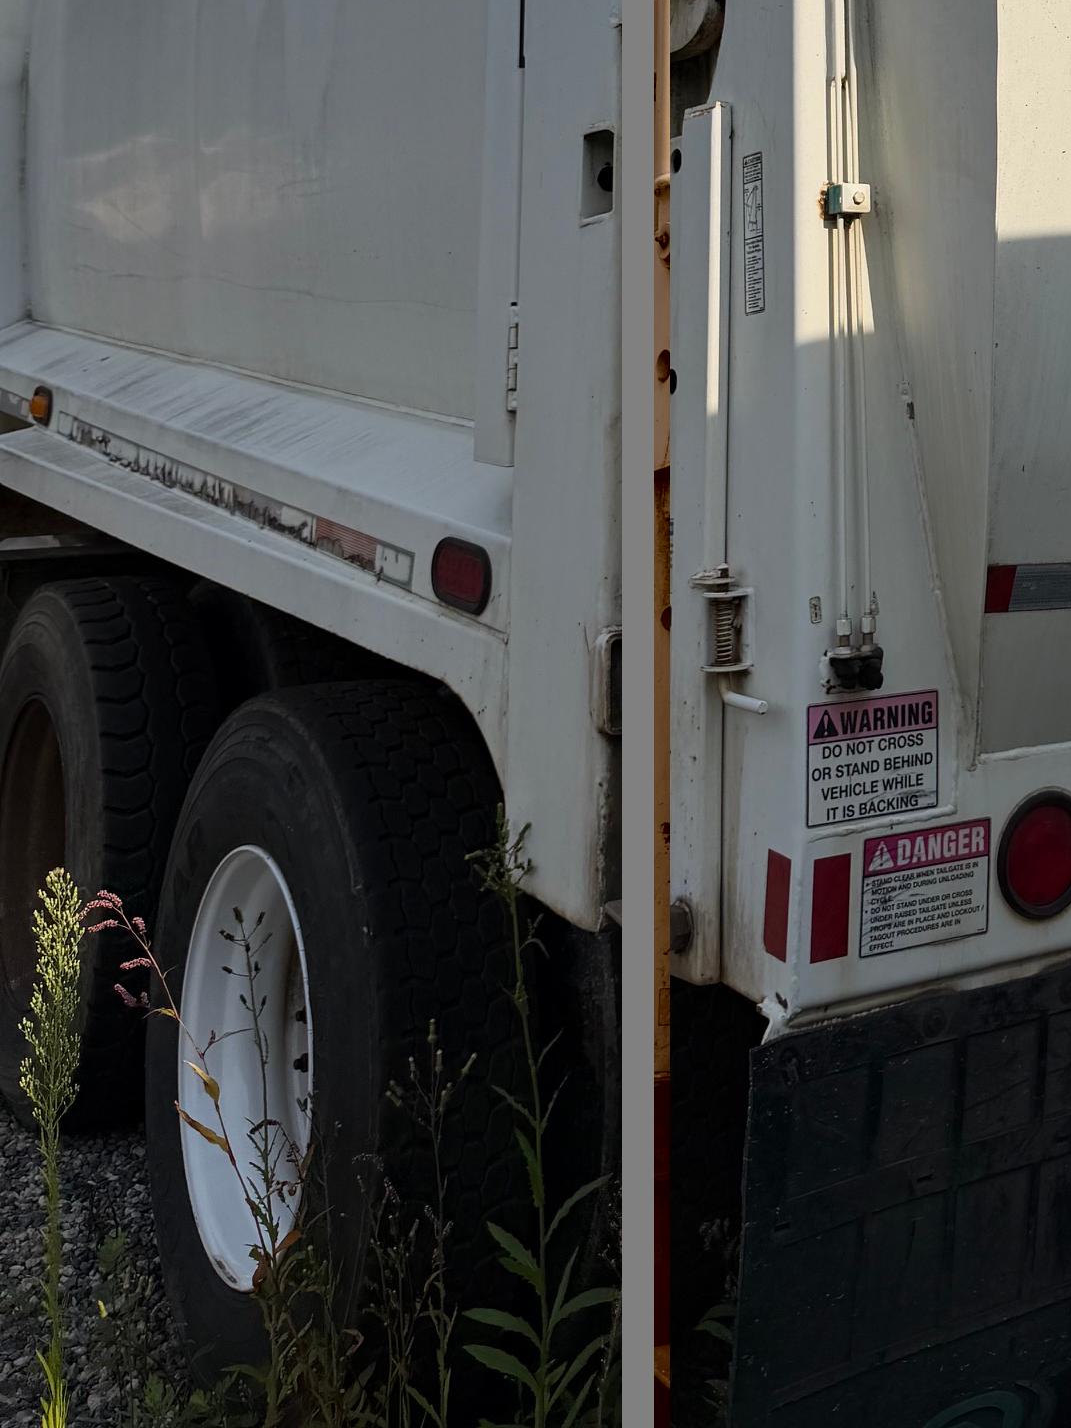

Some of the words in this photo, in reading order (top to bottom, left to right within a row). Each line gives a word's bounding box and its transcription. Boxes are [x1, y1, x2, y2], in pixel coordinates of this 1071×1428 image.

[840, 700, 933, 735] WARNING
[823, 745, 842, 759] DO
[847, 740, 874, 756] NOT
[879, 733, 924, 751] CROSS
[812, 767, 831, 781] OR
[836, 760, 879, 778] STAND
[884, 752, 933, 770] BEHIND
[821, 780, 878, 800] VEHICLE
[882, 773, 924, 791] WHILE
[827, 807, 839, 821] IT
[843, 805, 854, 818] IS
[860, 795, 918, 815] BACKING
[897, 826, 985, 866] DANGER
[871, 886, 897, 895] MOTION
[898, 883, 911, 891] AND
[913, 878, 937, 888] DURING
[939, 871, 974, 883] UNLOADING
[872, 876, 892, 887] STAND
[894, 872, 915, 882] CLEAR
[916, 869, 934, 878] WHEN
[936, 864, 963, 874] TAILGATE
[870, 913, 893, 923] UNDER
[895, 908, 917, 919] RAISED
[919, 903, 947, 914] TAILGATE
[948, 898, 972, 909] UNLESS
[896, 900, 916, 909] STAND
[918, 894, 940, 905] UNDER
[941, 892, 951, 900] OR
[952, 889, 973, 898] CROSS
[870, 923, 892, 933] PROPS
[893, 920, 906, 929] ARE
[915, 914, 936, 924] PLACE
[937, 911, 950, 919] AND
[951, 905, 980, 917] LOCKOUT
[870, 931, 895, 942] TAGOUT
[897, 923, 939, 937] PROCEDURES
[941, 920, 953, 928] ARE
